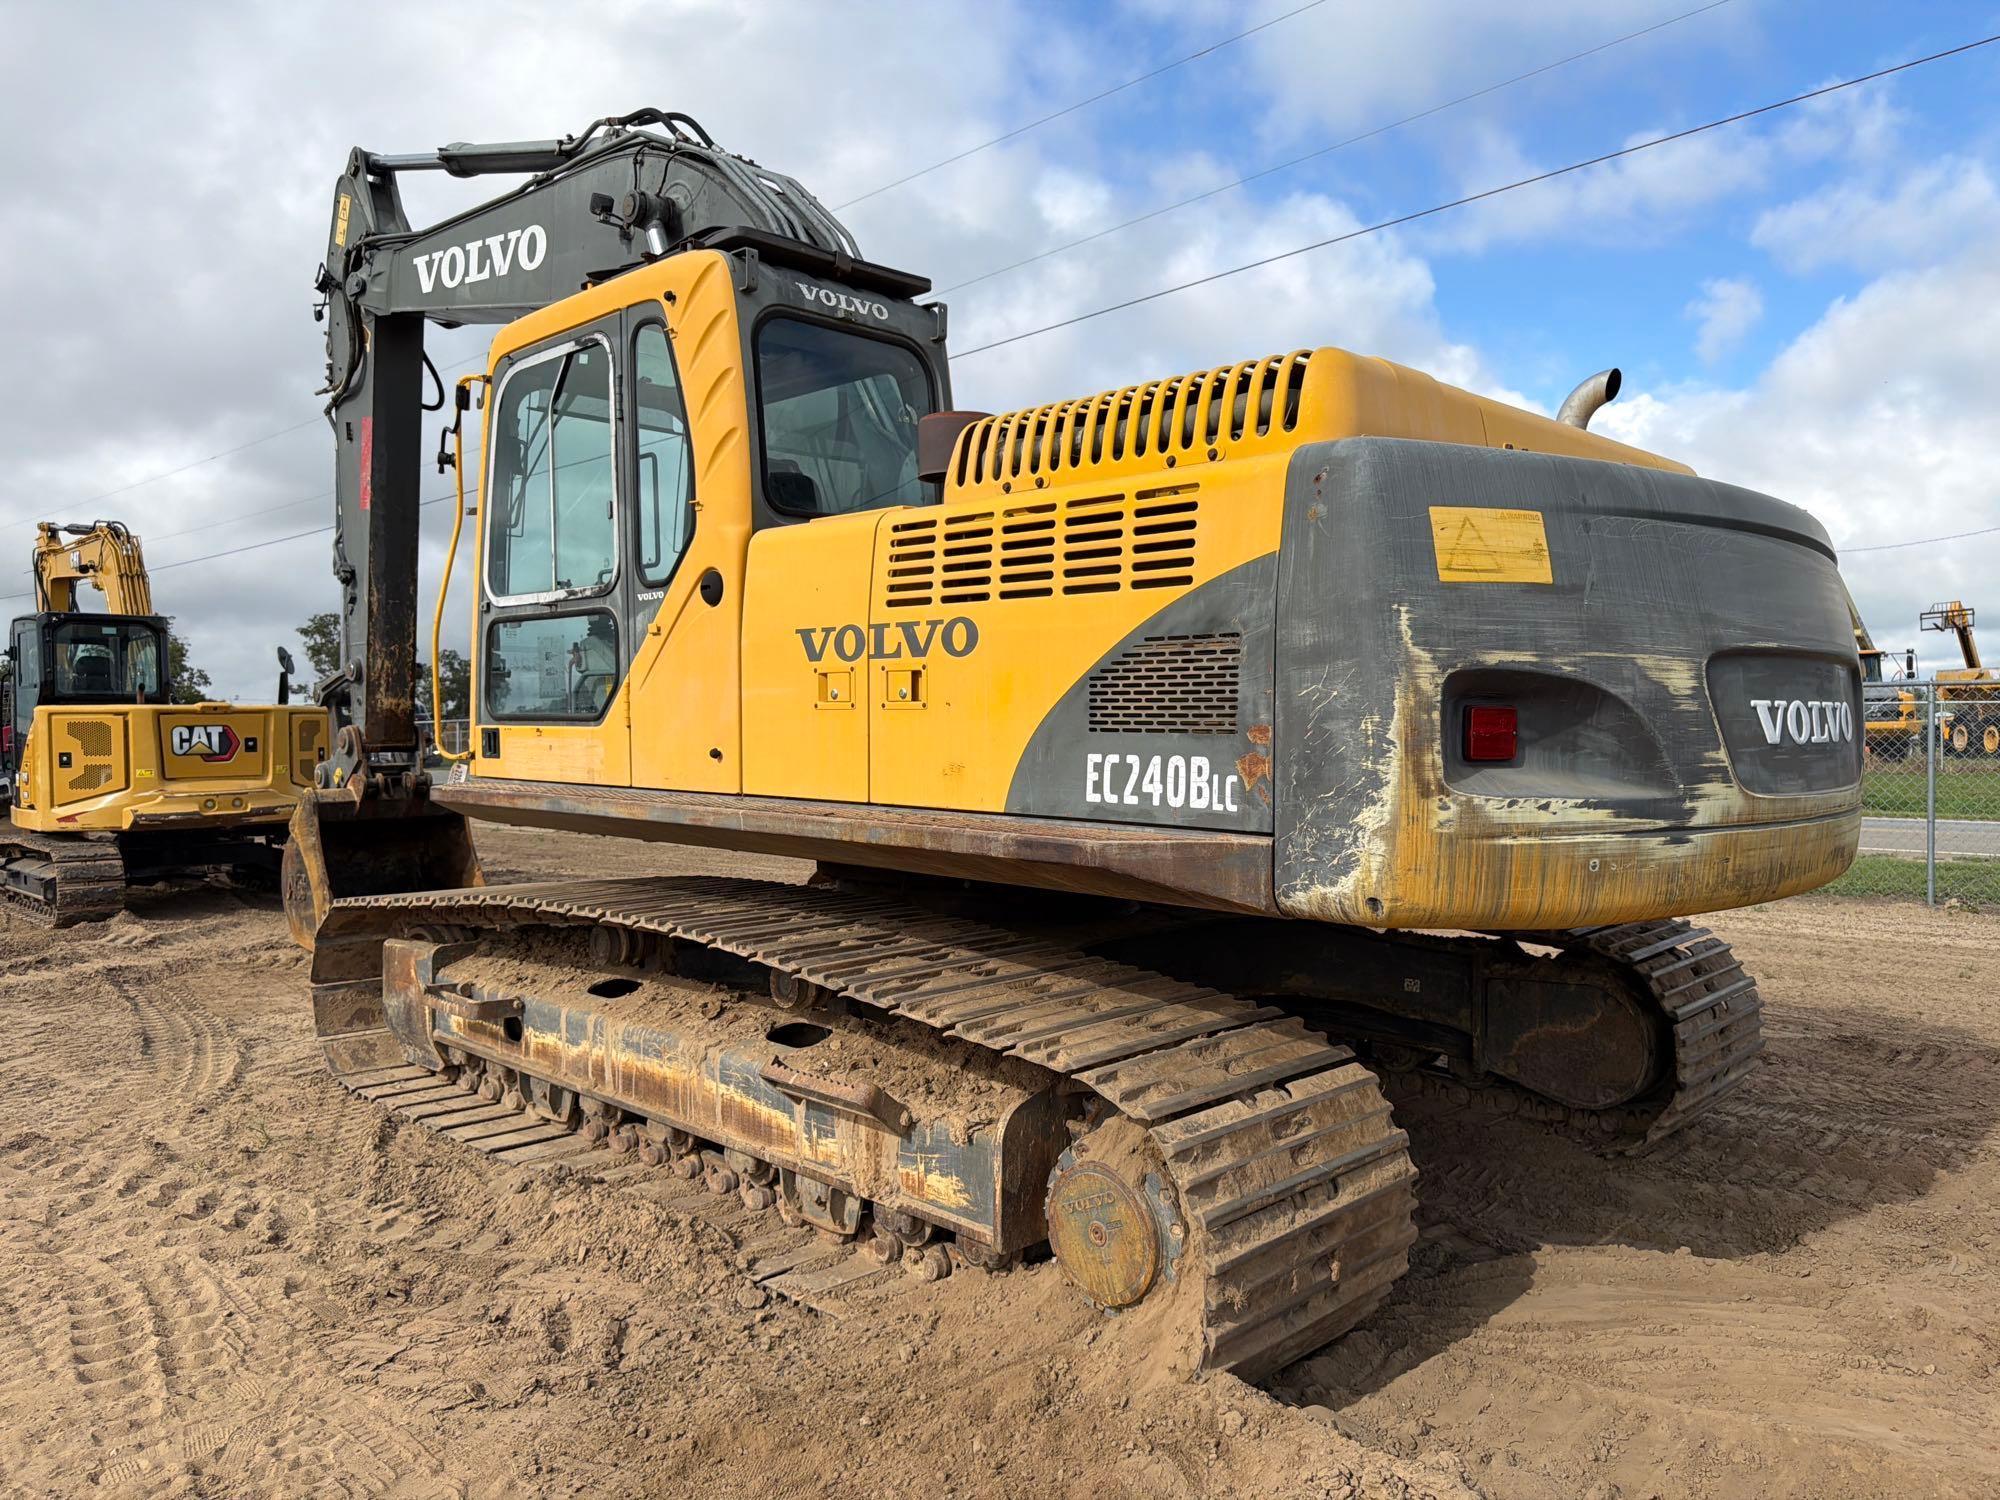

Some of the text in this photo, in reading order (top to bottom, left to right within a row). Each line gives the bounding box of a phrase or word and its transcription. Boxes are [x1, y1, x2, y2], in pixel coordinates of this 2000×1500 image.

[413, 224, 547, 294] VOLVO
[795, 281, 889, 321] VOLVO
[637, 591, 664, 602] VOLVO
[795, 616, 979, 663] VOLVO
[172, 725, 223, 756] CAT
[1750, 699, 1853, 745] VOLVO
[1085, 753, 1238, 812] EC240BLC
[1062, 1190, 1115, 1214] VOLVO
